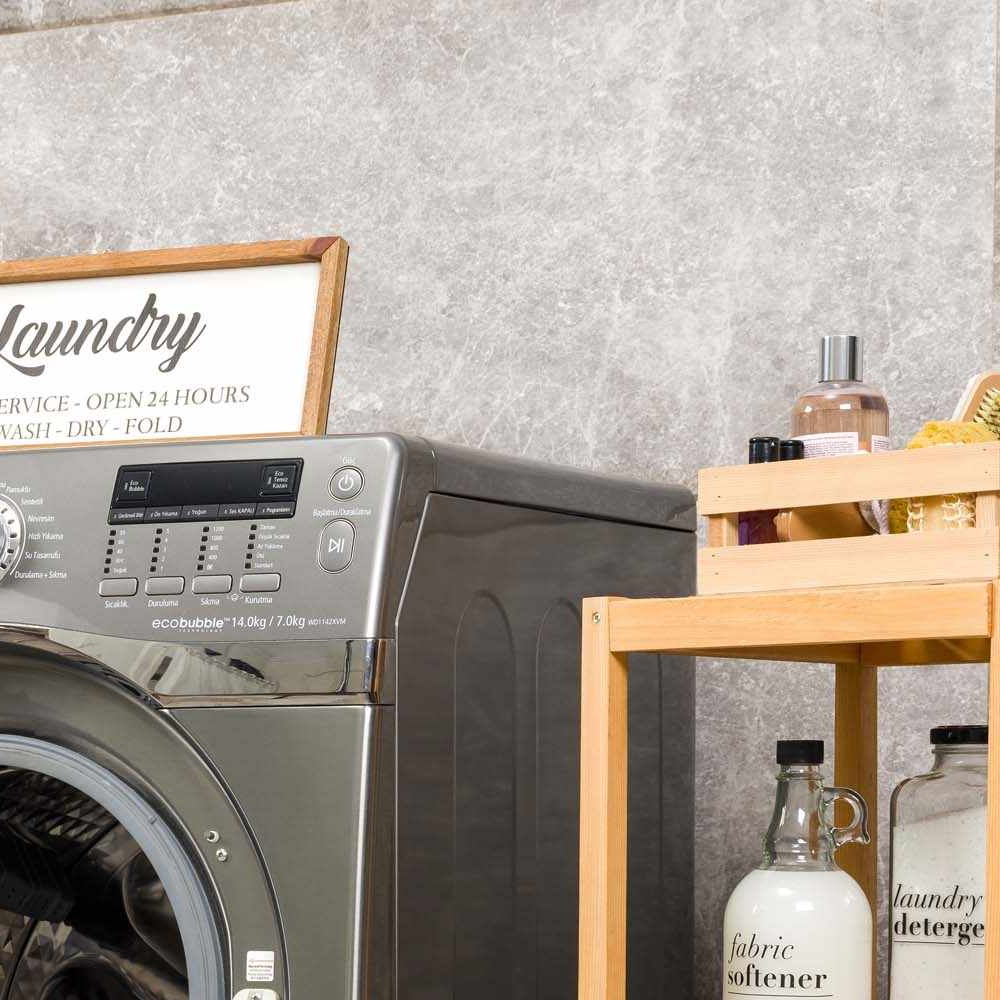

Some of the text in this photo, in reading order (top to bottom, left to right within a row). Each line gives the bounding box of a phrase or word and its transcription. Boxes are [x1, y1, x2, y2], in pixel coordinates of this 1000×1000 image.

[86, 391, 143, 411] OPEN
[147, 391, 169, 408] 24
[174, 385, 251, 406] HOURS
[67, 419, 110, 438] DRY
[125, 416, 183, 435] FOLD
[244, 595, 273, 605] Kurutma
[231, 616, 267, 630] 14.0kg
[276, 615, 306, 629] 7.0kg
[893, 884, 983, 917] laundry
[728, 932, 795, 963] fabric
[727, 963, 828, 989] softener
